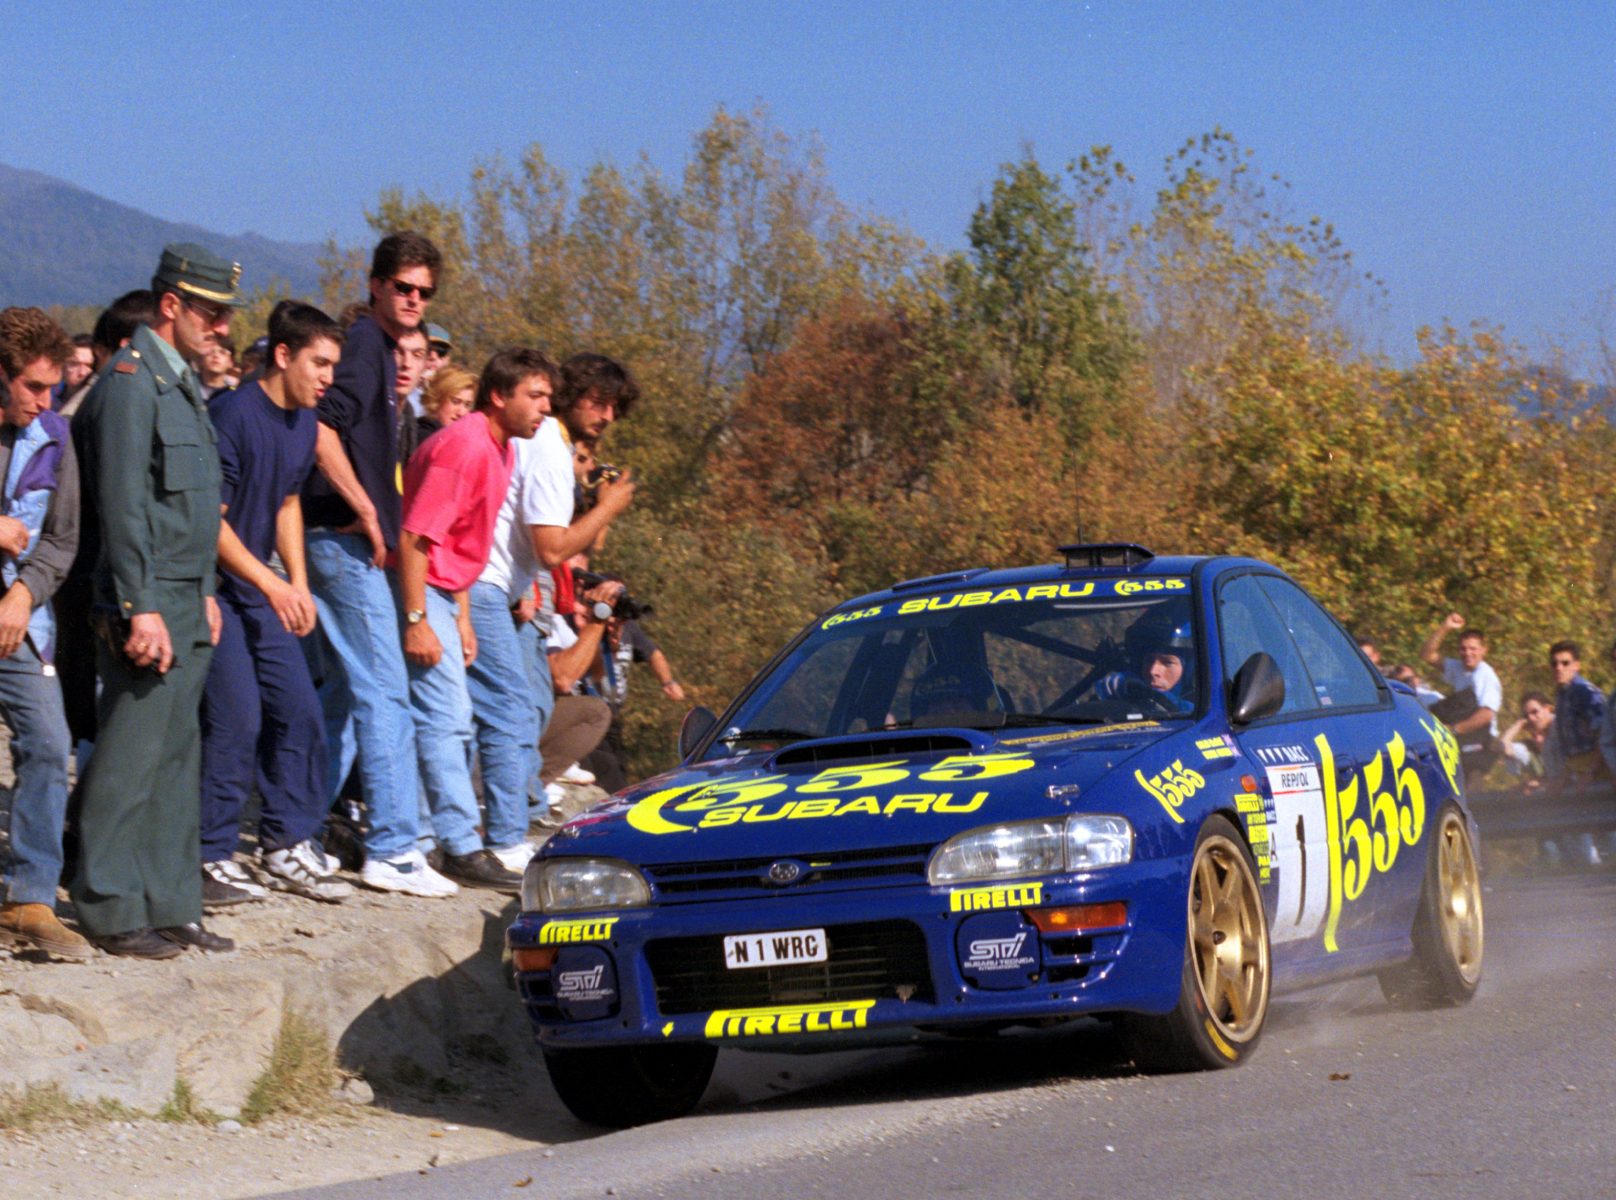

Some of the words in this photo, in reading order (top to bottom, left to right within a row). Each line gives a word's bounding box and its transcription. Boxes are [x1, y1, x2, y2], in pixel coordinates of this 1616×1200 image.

[897, 582, 1095, 615] SUBARU
[675, 752, 1036, 811] 555
[1150, 758, 1206, 808] 555
[698, 791, 990, 828] SUBARU
[1338, 731, 1426, 901] 555
[1294, 814, 1308, 927] 1
[950, 882, 1044, 912] PIRELLI
[539, 917, 620, 944] PIRELLI
[735, 940, 749, 963] N
[755, 939, 765, 961] 1
[704, 999, 877, 1039] PIRELLI
